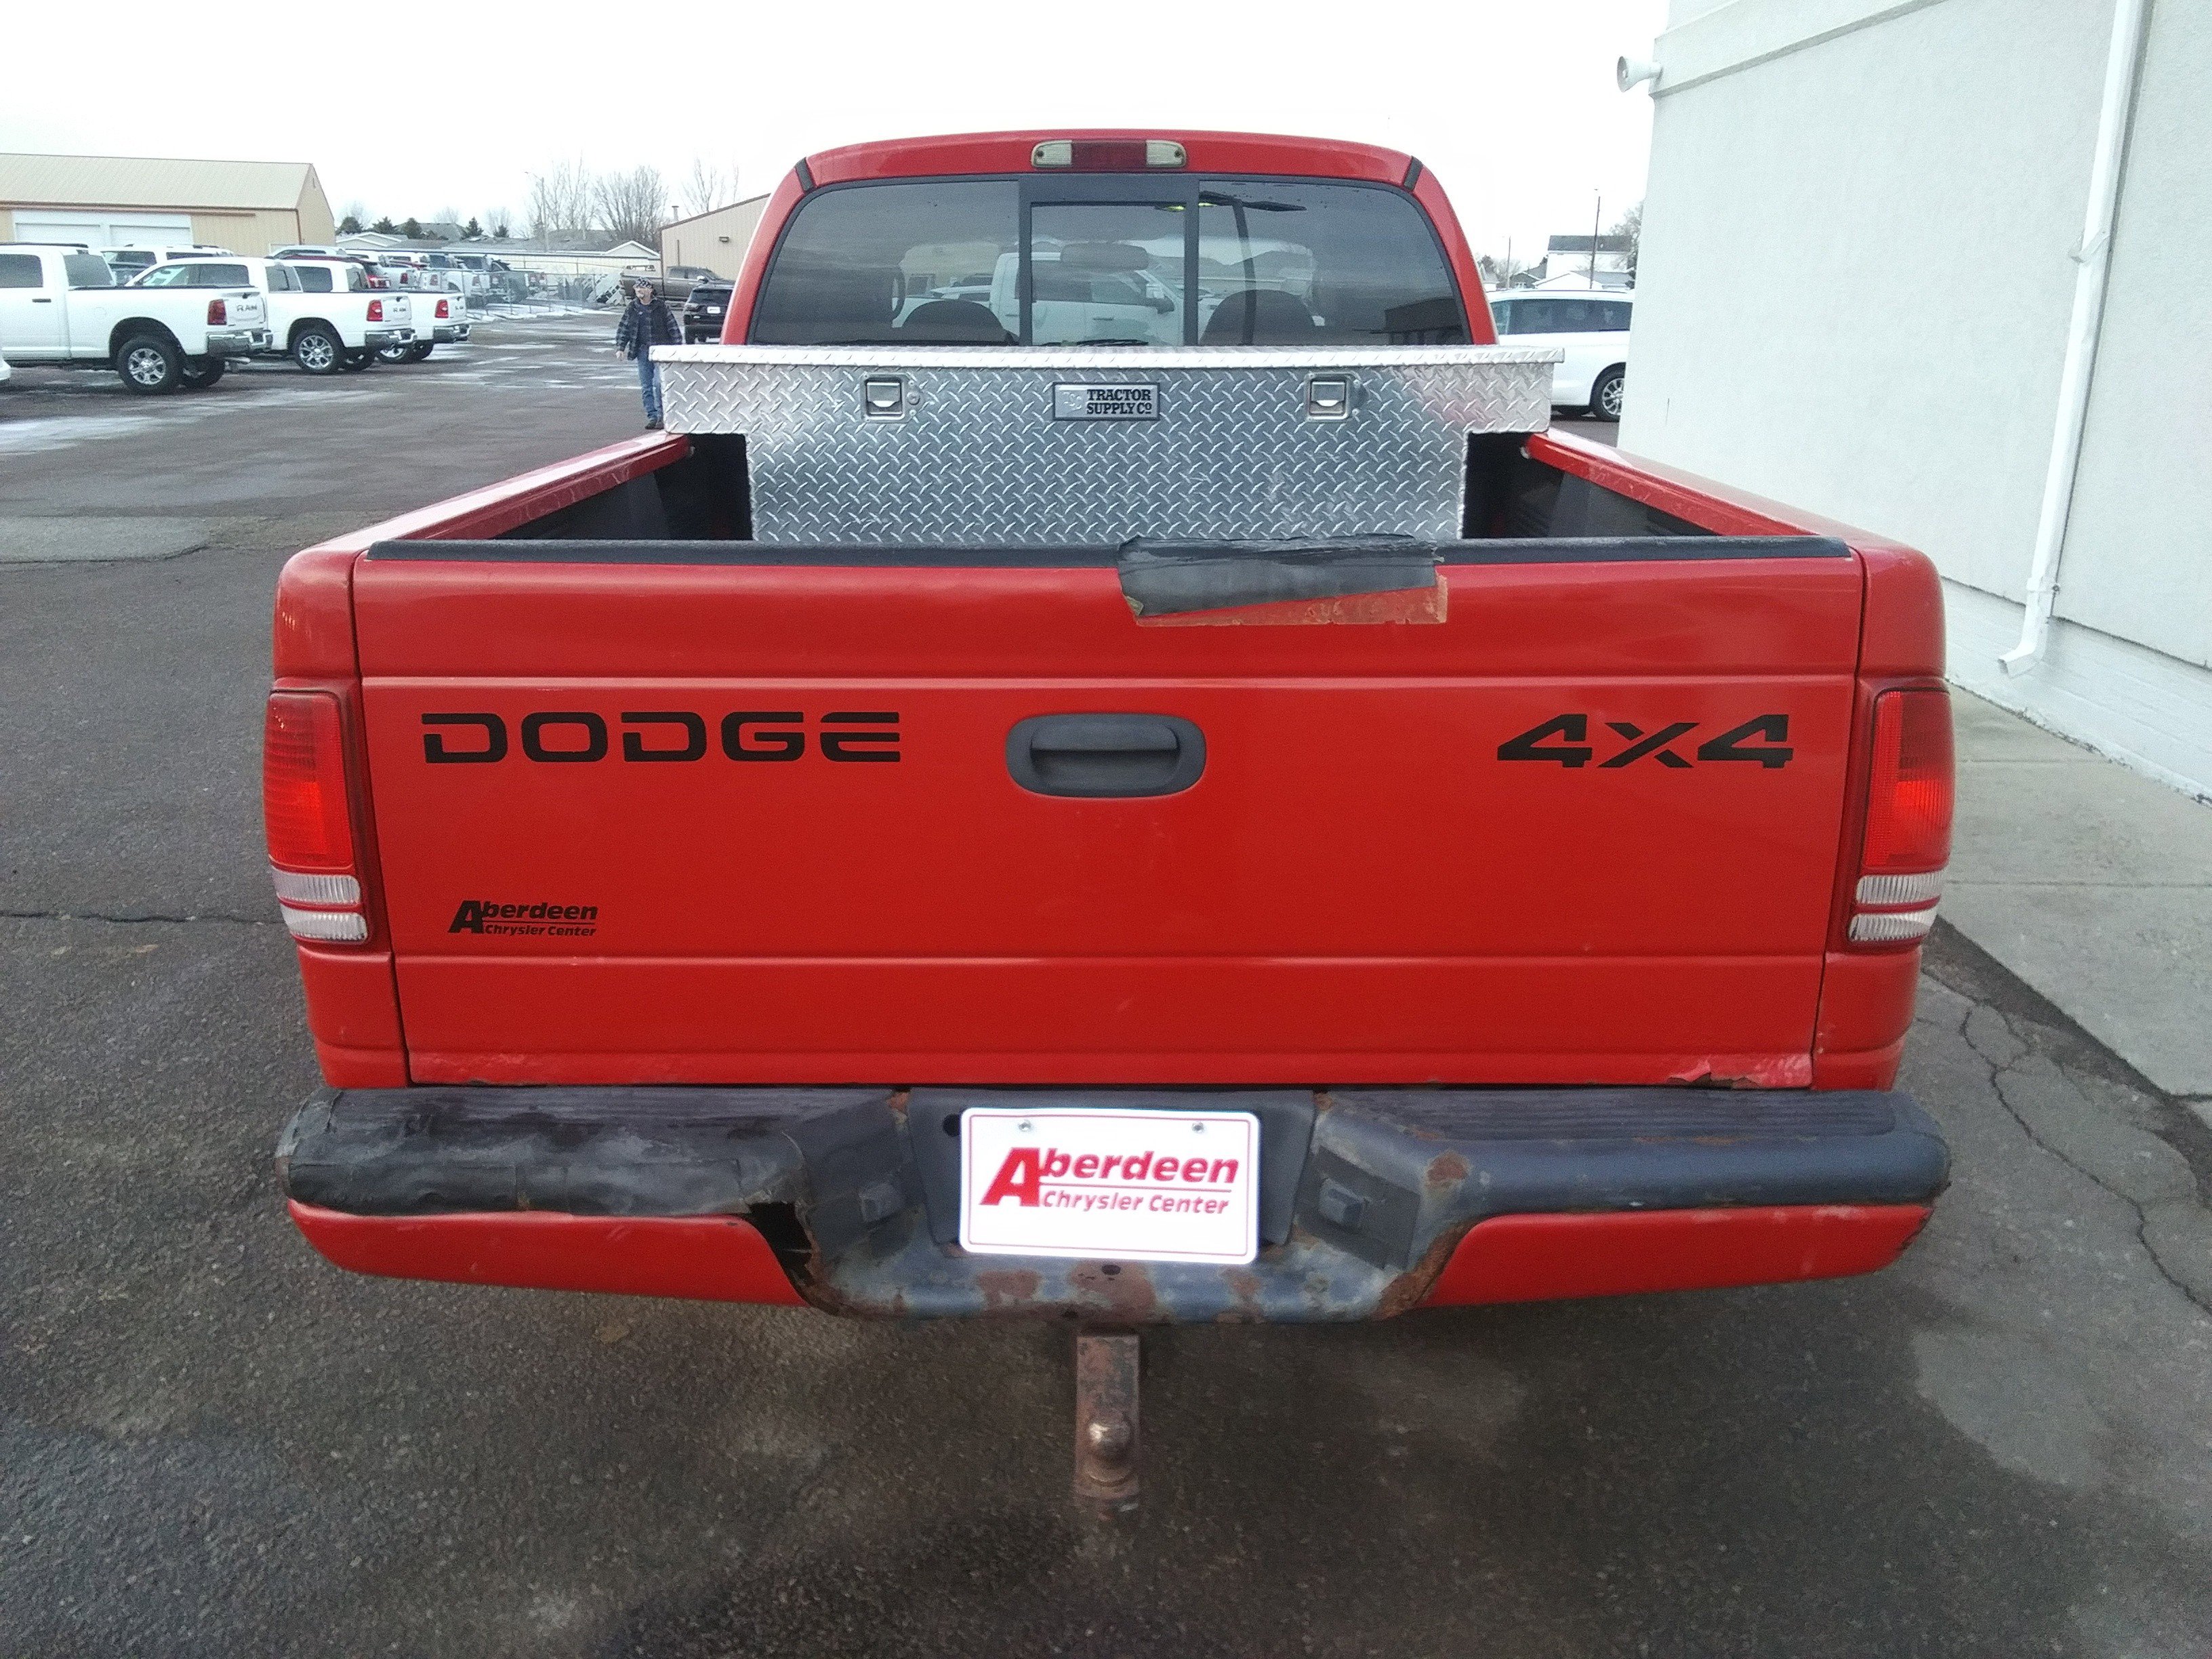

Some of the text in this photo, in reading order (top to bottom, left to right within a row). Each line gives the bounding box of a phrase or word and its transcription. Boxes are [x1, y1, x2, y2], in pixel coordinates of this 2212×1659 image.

[1087, 389, 1151, 401] TRACTOR
[1087, 403, 1136, 415] SUPPLY
[422, 712, 901, 764] DODGE
[447, 900, 598, 934] Aberdeen
[485, 924, 596, 936] Chrysler Center
[979, 1147, 1240, 1207] Aberdeen
[1043, 1189, 1229, 1214] Chrysler Center
